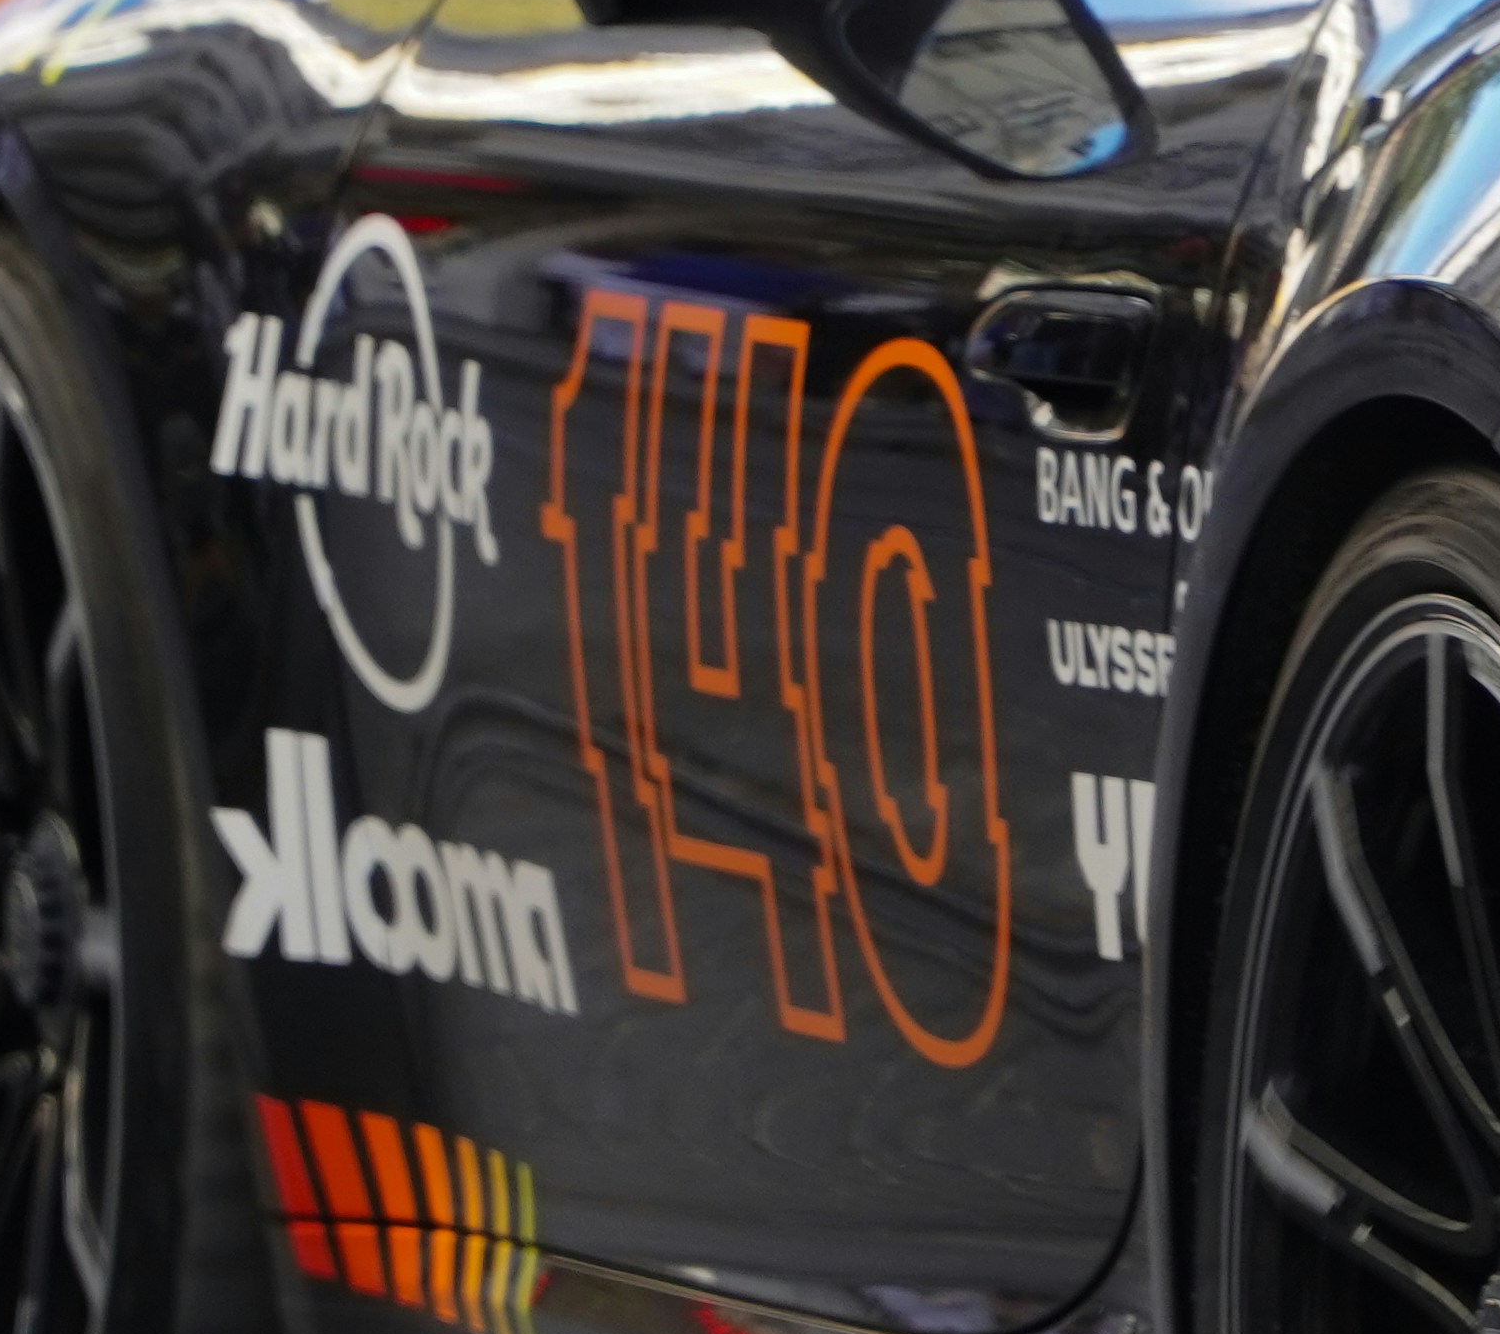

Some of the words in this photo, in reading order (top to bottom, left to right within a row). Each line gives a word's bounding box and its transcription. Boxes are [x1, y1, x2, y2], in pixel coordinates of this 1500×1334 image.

[210, 311, 376, 499] Hard
[371, 338, 499, 566] Rock
[1036, 446, 1137, 534] BANG
[1145, 460, 1173, 538] &
[540, 291, 1011, 1068] 140
